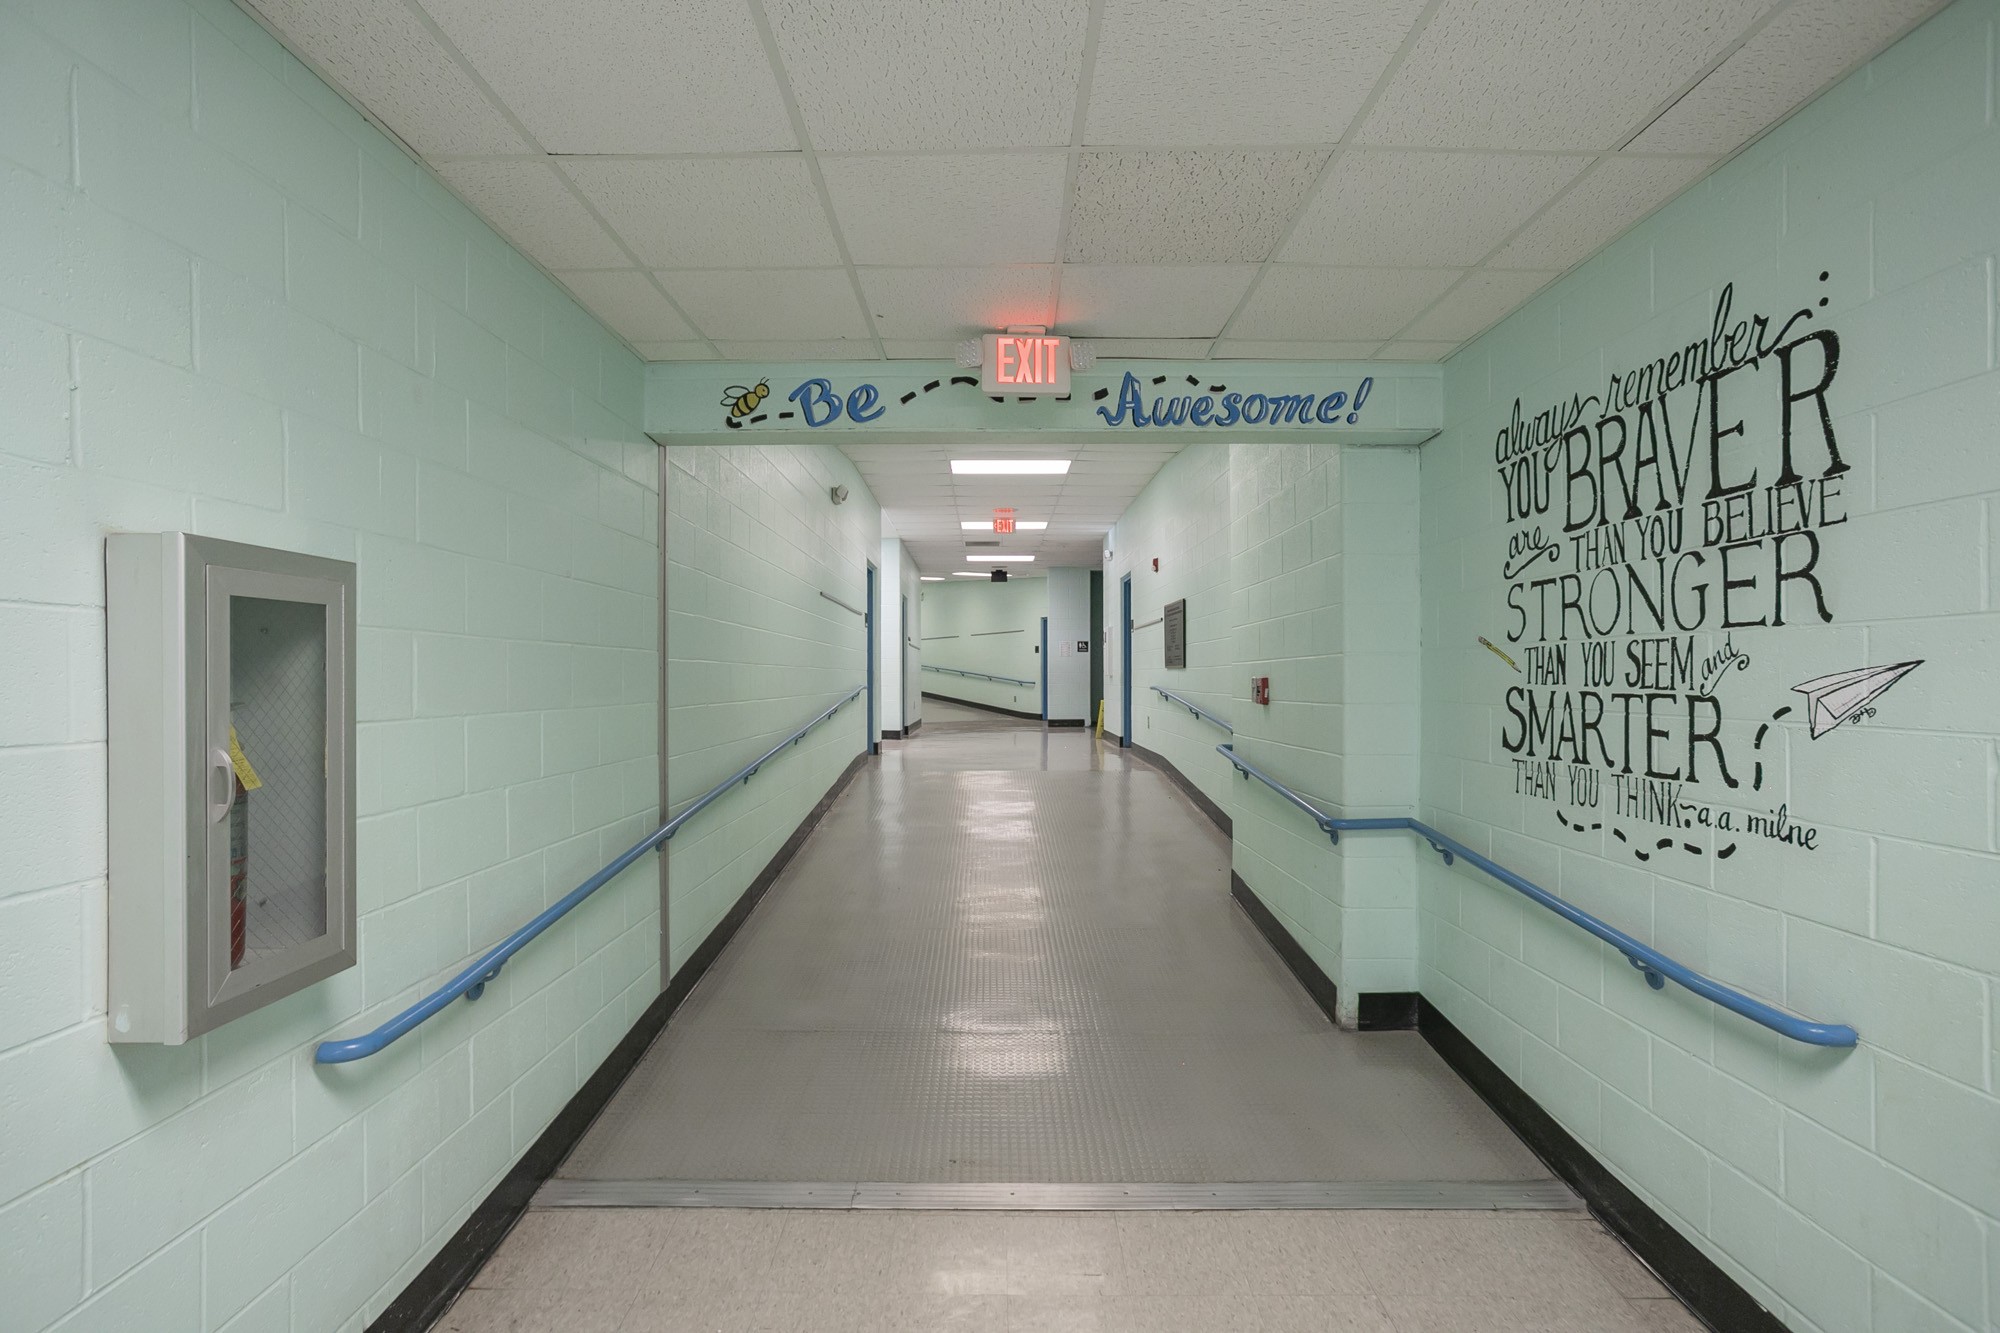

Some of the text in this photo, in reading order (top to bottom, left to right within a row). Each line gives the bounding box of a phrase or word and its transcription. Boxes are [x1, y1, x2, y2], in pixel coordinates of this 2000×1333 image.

[788, 371, 1375, 428] Be Awesome!
[996, 337, 1060, 384] EXIT
[1496, 392, 1601, 473] always
[1498, 329, 1851, 533] YOU BRAVER
[996, 519, 1014, 533] EXIT
[1507, 525, 1554, 567] are
[1569, 474, 1848, 573] THAN YOU BELIEVE
[1507, 529, 1834, 643] STRONGER
[1524, 632, 1744, 692] THAN YOU SEEM and
[1502, 686, 1740, 789] SMARTER
[1512, 758, 1557, 801] THAN
[1568, 764, 1600, 808] YOU
[1747, 803, 1820, 850] milne
